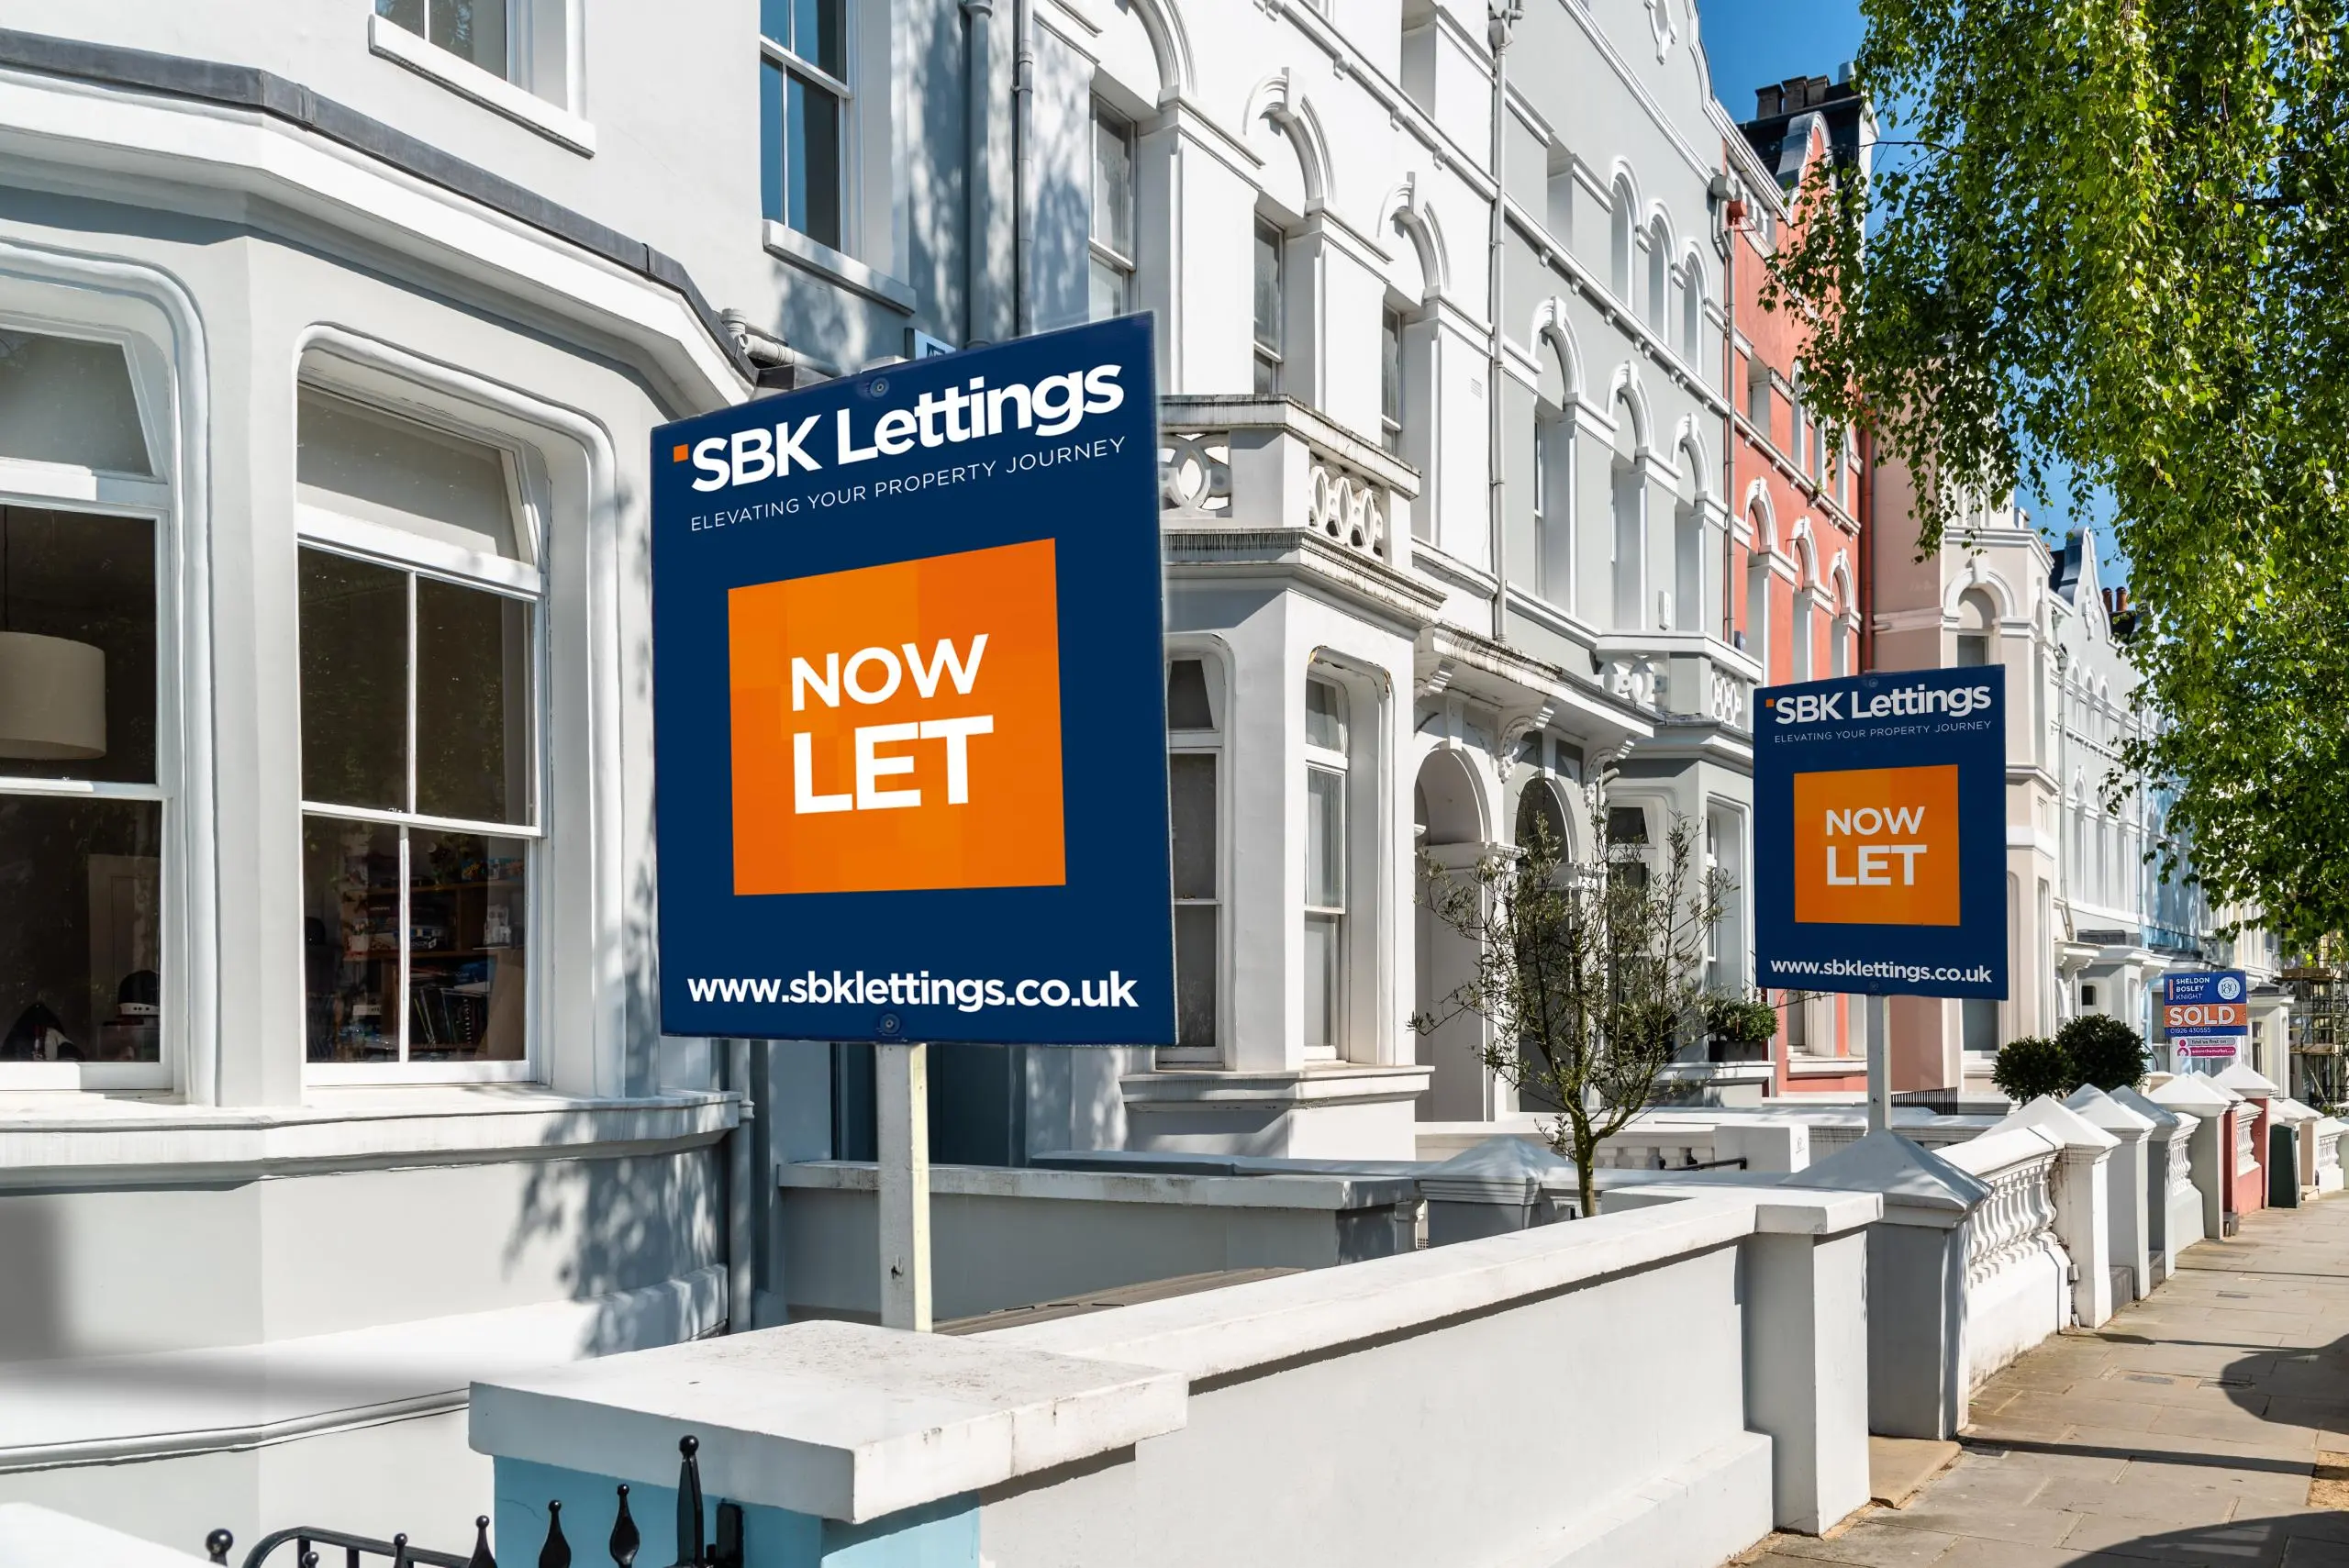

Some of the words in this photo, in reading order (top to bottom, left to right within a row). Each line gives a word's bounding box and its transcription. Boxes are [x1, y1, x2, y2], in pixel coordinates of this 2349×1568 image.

[691, 414, 823, 493] SBK
[837, 364, 1125, 465] Lettings
[691, 497, 800, 531] ELEVATING
[807, 485, 867, 510] YOUR
[874, 460, 997, 497] PROPERTY
[1006, 436, 1126, 473] JOURNEY
[791, 633, 989, 712] NOW
[1775, 692, 1844, 725] SBK
[1851, 684, 1992, 719] Lettings
[1775, 732, 1832, 743] ELEVATING
[1835, 729, 1866, 740] YOUR
[1870, 725, 1930, 737] PROPERTY
[1934, 720, 1992, 733] JOURNEY
[793, 715, 994, 815] LET
[1826, 806, 1925, 836] NOW
[1827, 844, 1927, 885] LET
[687, 970, 1140, 1013] www.sbklettings.co.uk
[1770, 959, 1992, 983] www.sbklettings.co.uk
[2169, 1006, 2235, 1026] SOLD
